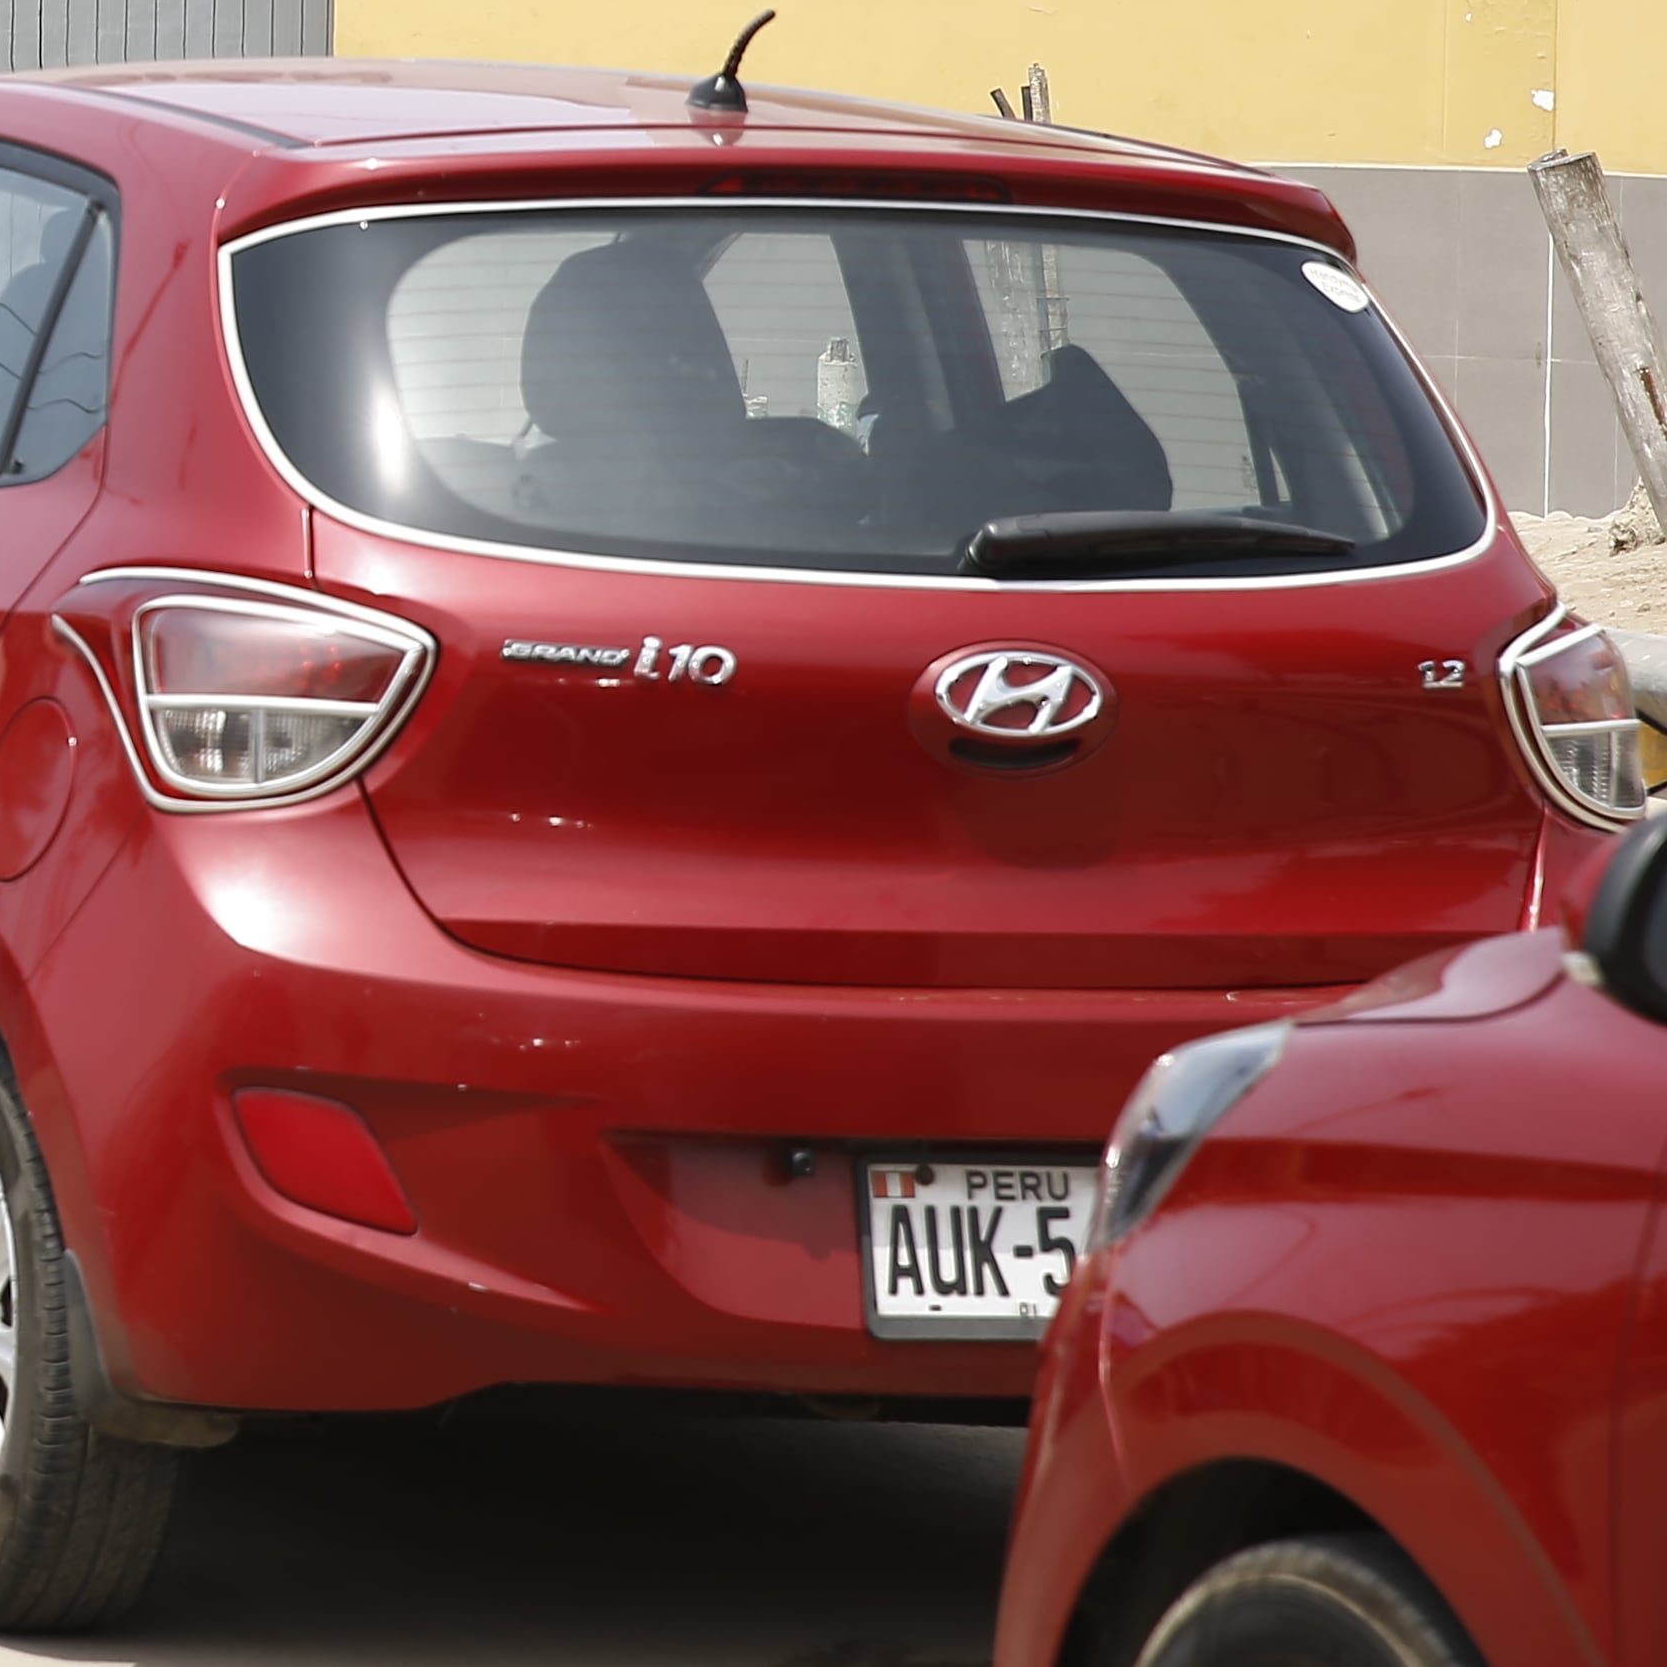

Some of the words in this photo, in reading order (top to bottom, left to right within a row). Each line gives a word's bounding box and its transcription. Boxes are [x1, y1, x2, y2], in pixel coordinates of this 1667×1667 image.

[505, 640, 627, 665] GRAND
[634, 636, 736, 684] i10
[967, 1171, 1069, 1201] PERU
